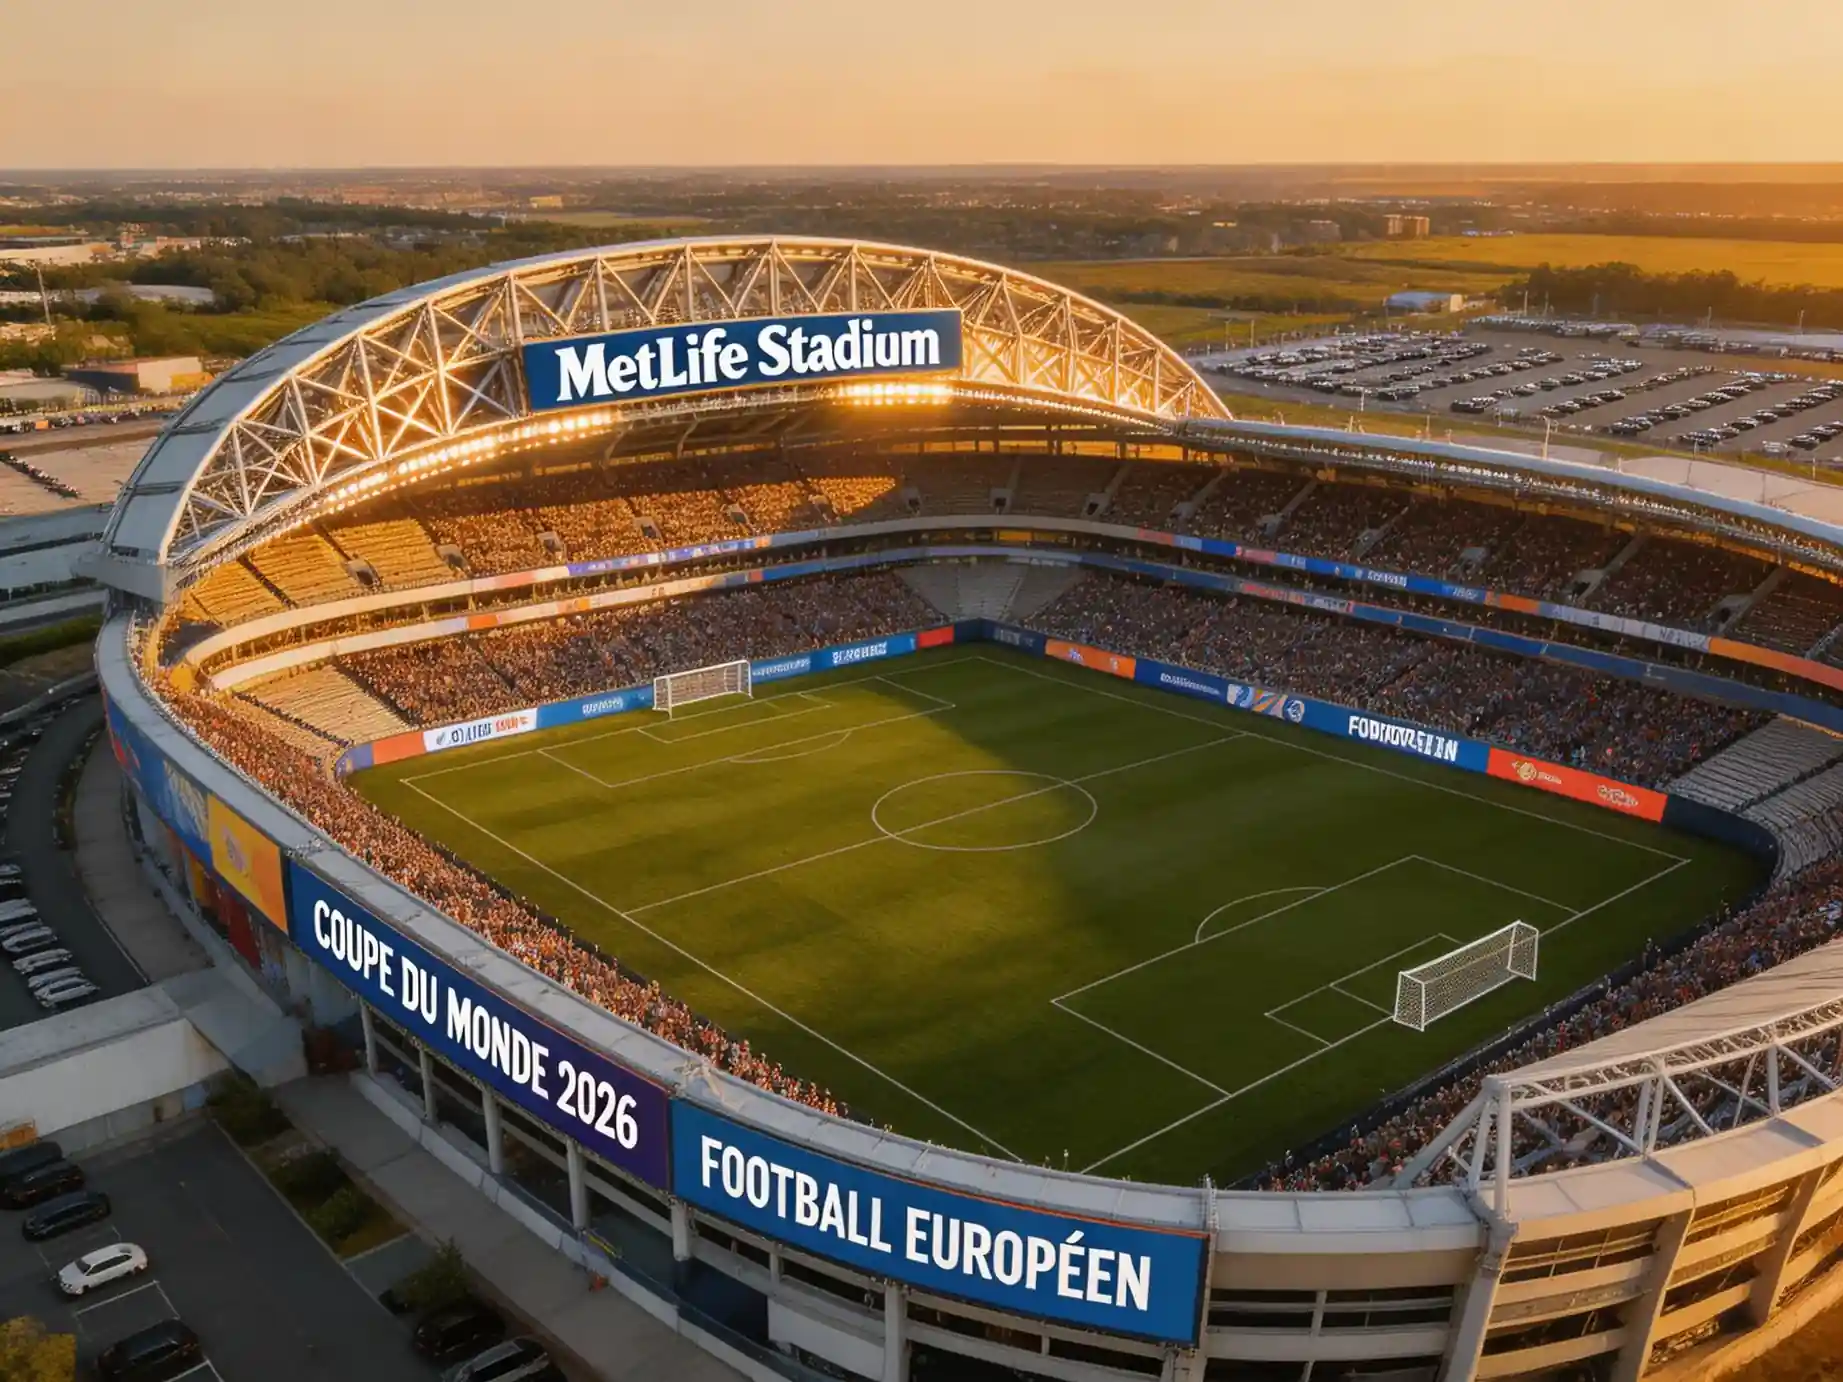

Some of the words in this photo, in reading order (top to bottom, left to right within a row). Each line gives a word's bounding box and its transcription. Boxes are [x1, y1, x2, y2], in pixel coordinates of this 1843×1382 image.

[555, 328, 749, 402] MetLife
[757, 318, 941, 376] Stadium
[314, 899, 395, 997] COUPE
[401, 955, 438, 1025] DU
[447, 986, 549, 1100] MONDE
[556, 1060, 638, 1149] 2026
[701, 1135, 892, 1253] FOOTBALL
[905, 1206, 1151, 1311] EUROPÉEN
